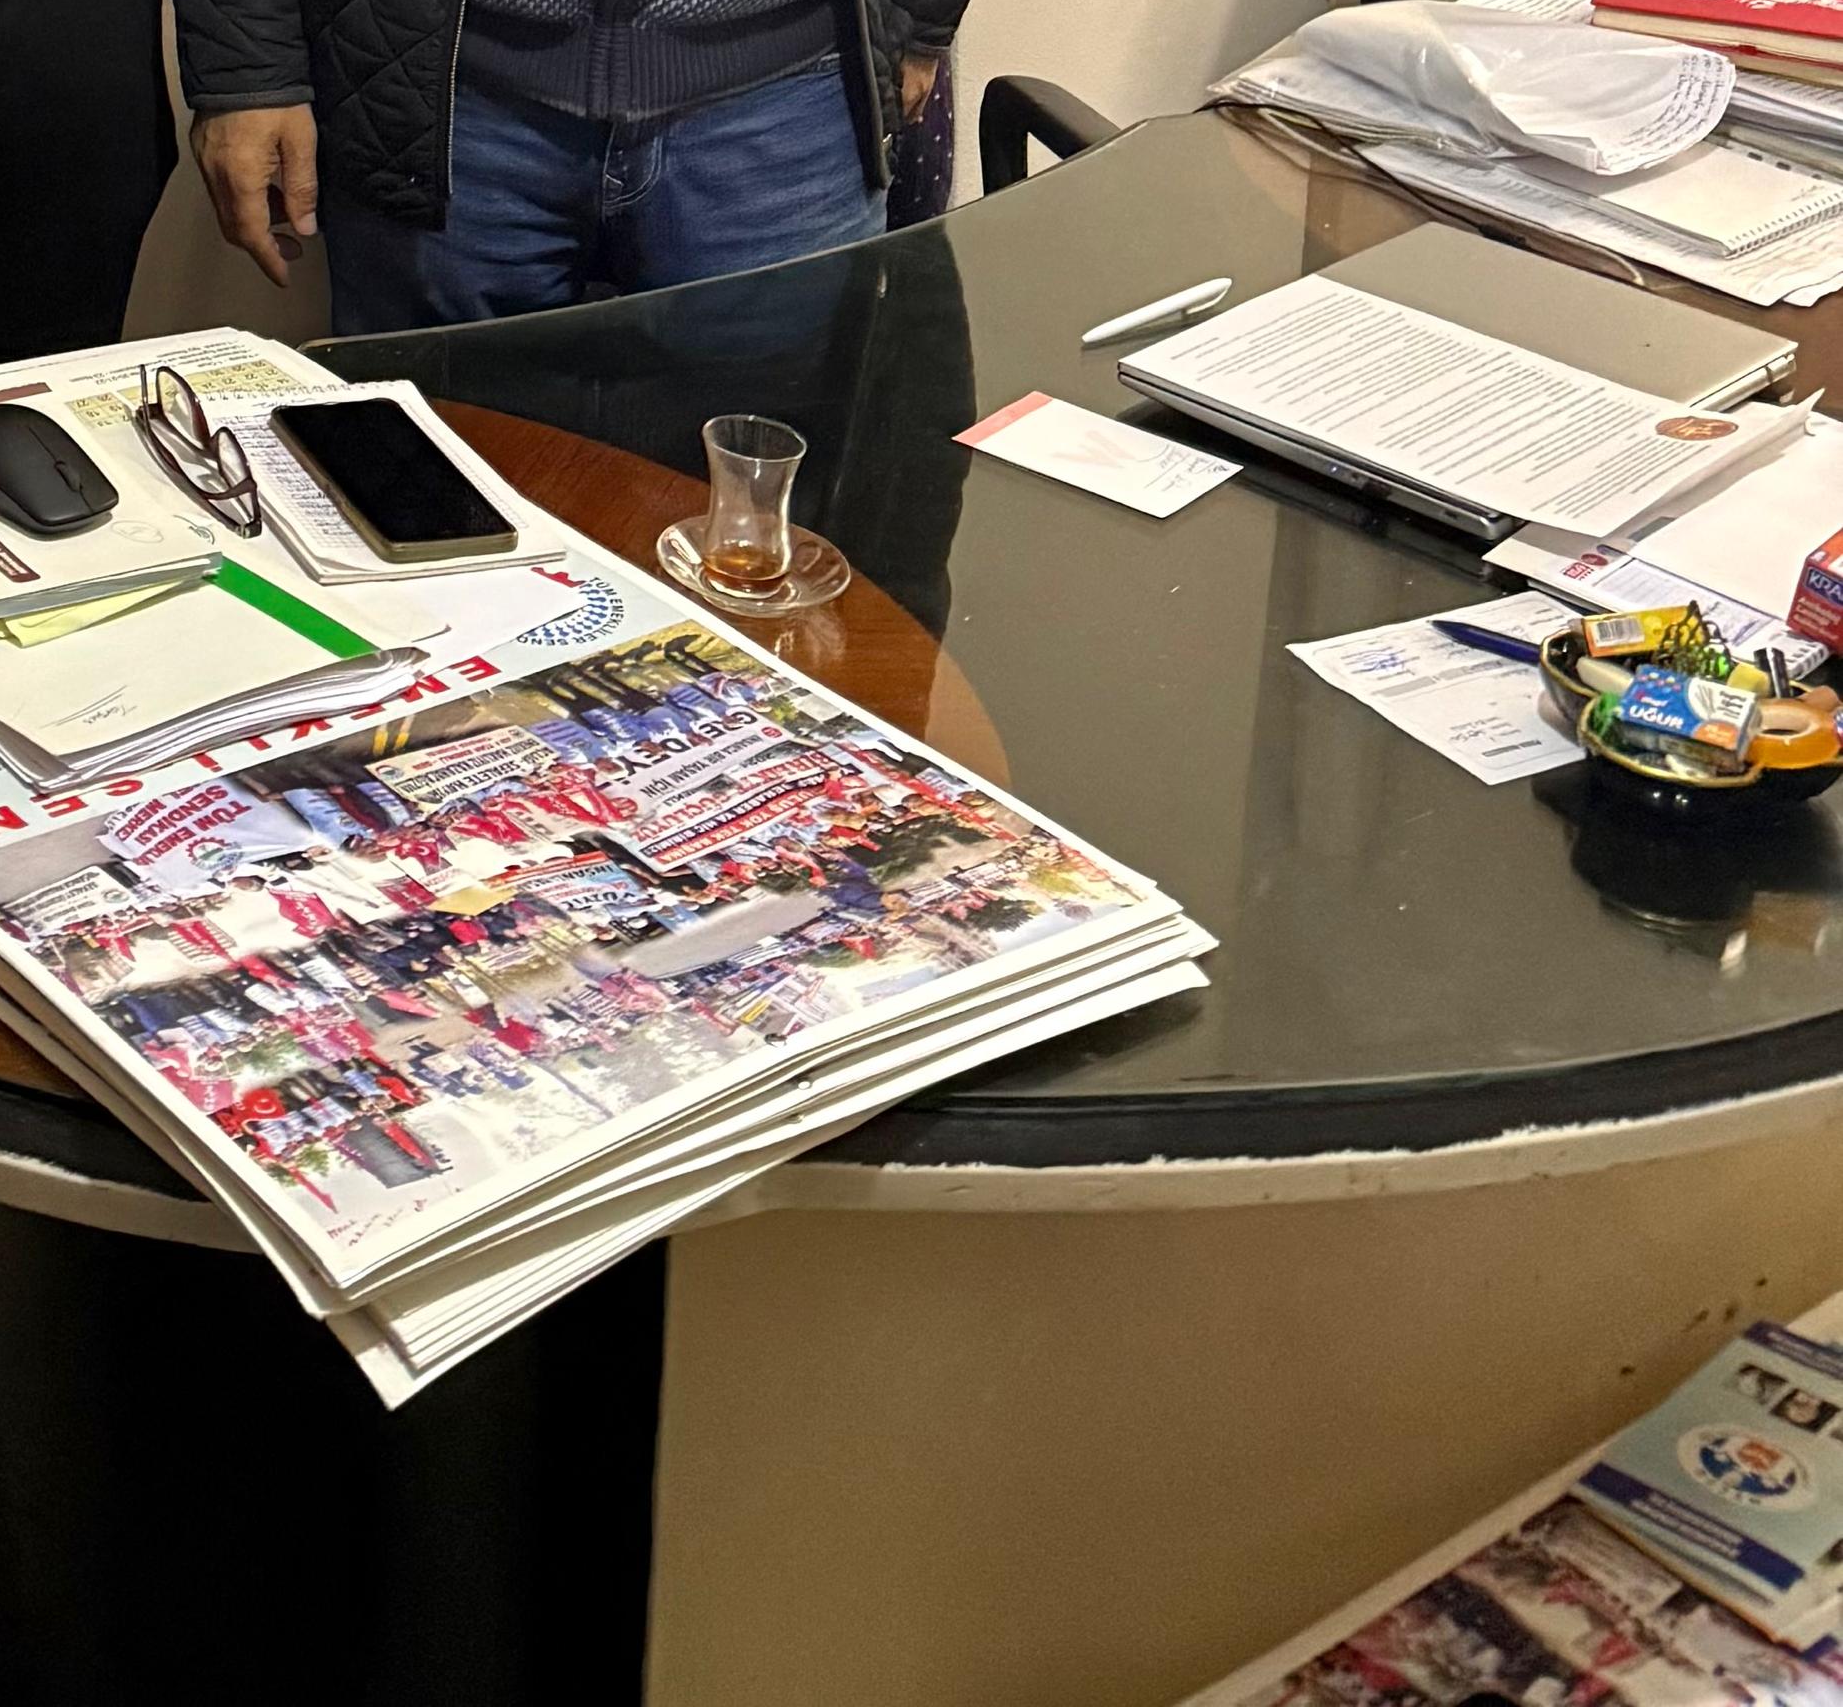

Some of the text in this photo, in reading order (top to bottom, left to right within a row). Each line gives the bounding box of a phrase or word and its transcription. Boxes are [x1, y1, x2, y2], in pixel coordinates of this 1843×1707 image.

[1629, 703, 1684, 731] UĞUR
[663, 758, 709, 783] YAŞAM
[636, 778, 675, 797] İÇİN
[131, 783, 232, 846] SENDİKASI
[190, 798, 252, 832] TÜM
